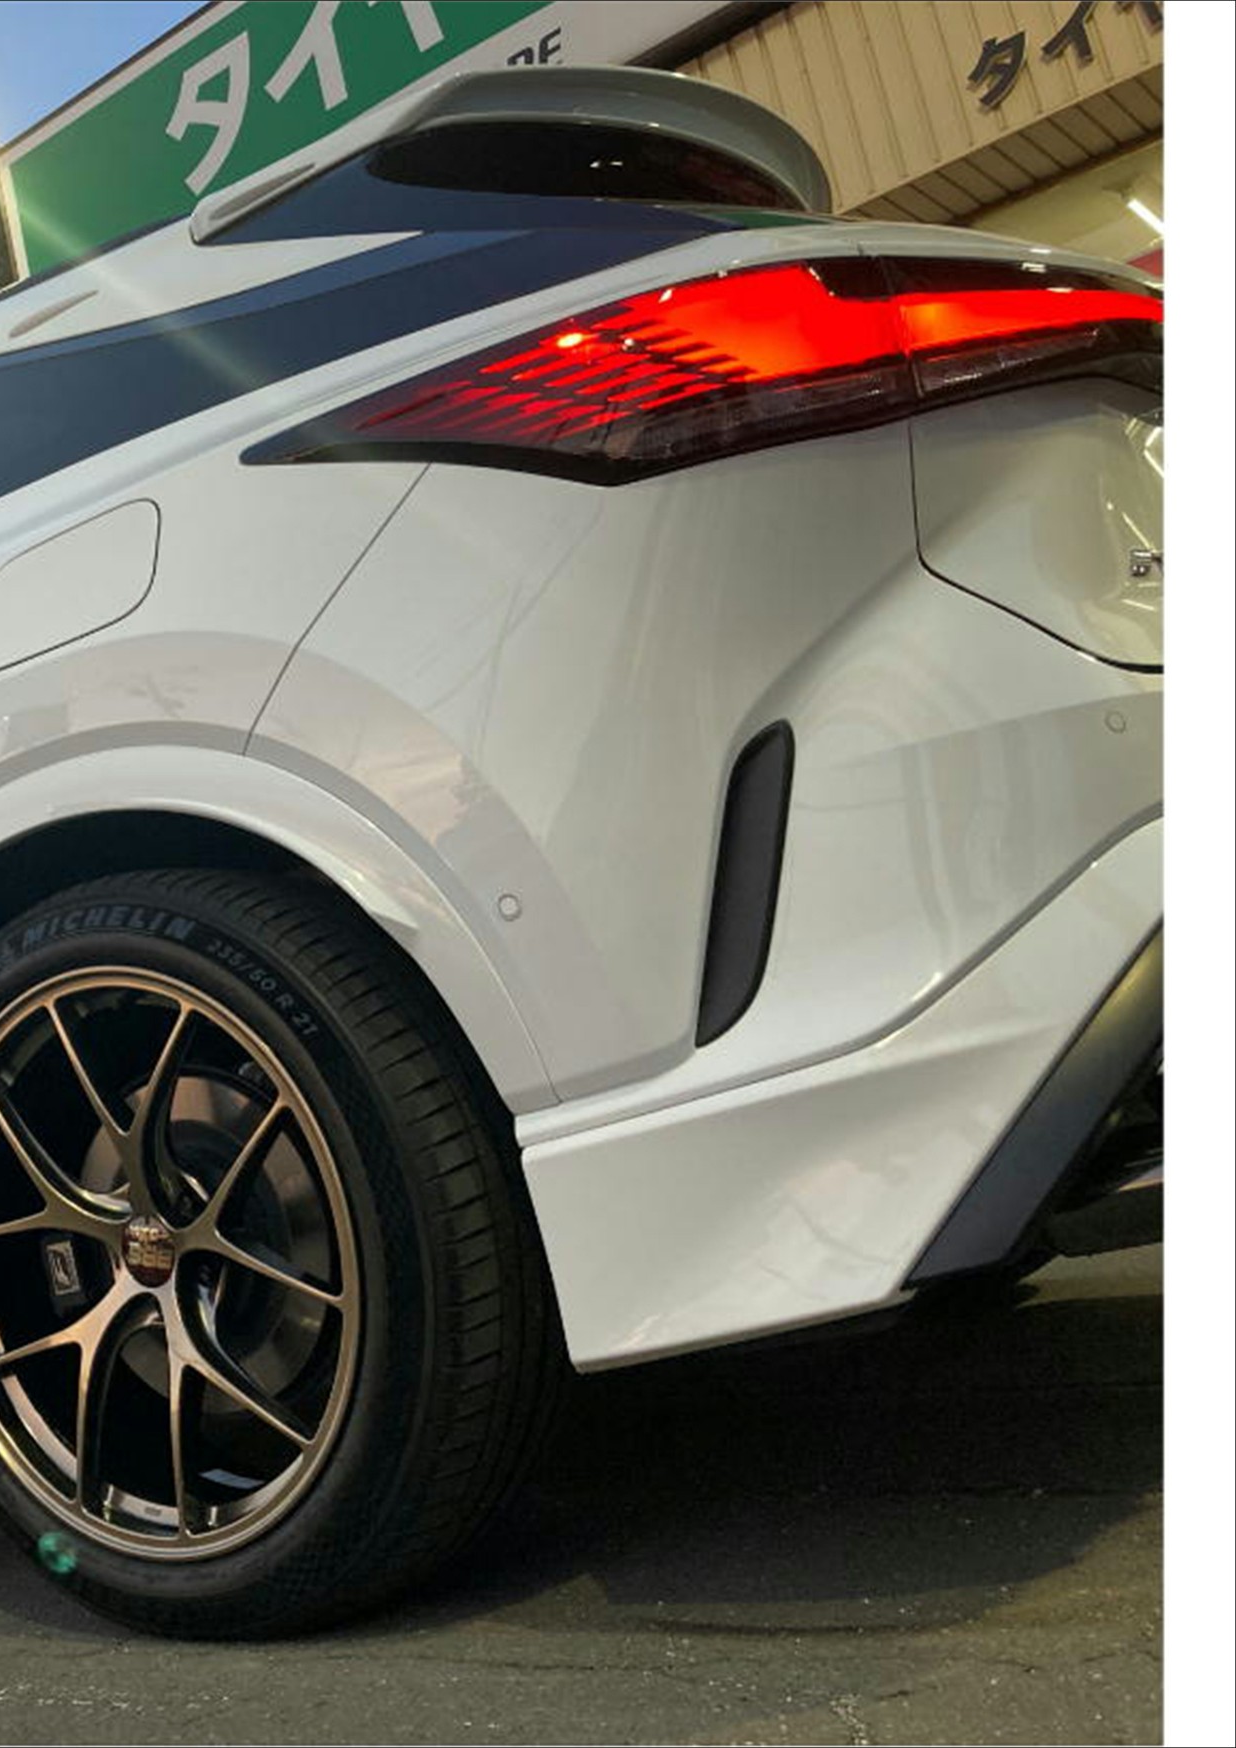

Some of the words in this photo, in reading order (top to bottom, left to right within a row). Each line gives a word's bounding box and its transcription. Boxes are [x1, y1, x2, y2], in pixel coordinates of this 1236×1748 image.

[22, 904, 197, 950] MICHELIN
[207, 938, 278, 992] 235/50
[274, 992, 296, 1009] R
[290, 1011, 320, 1036] 21
